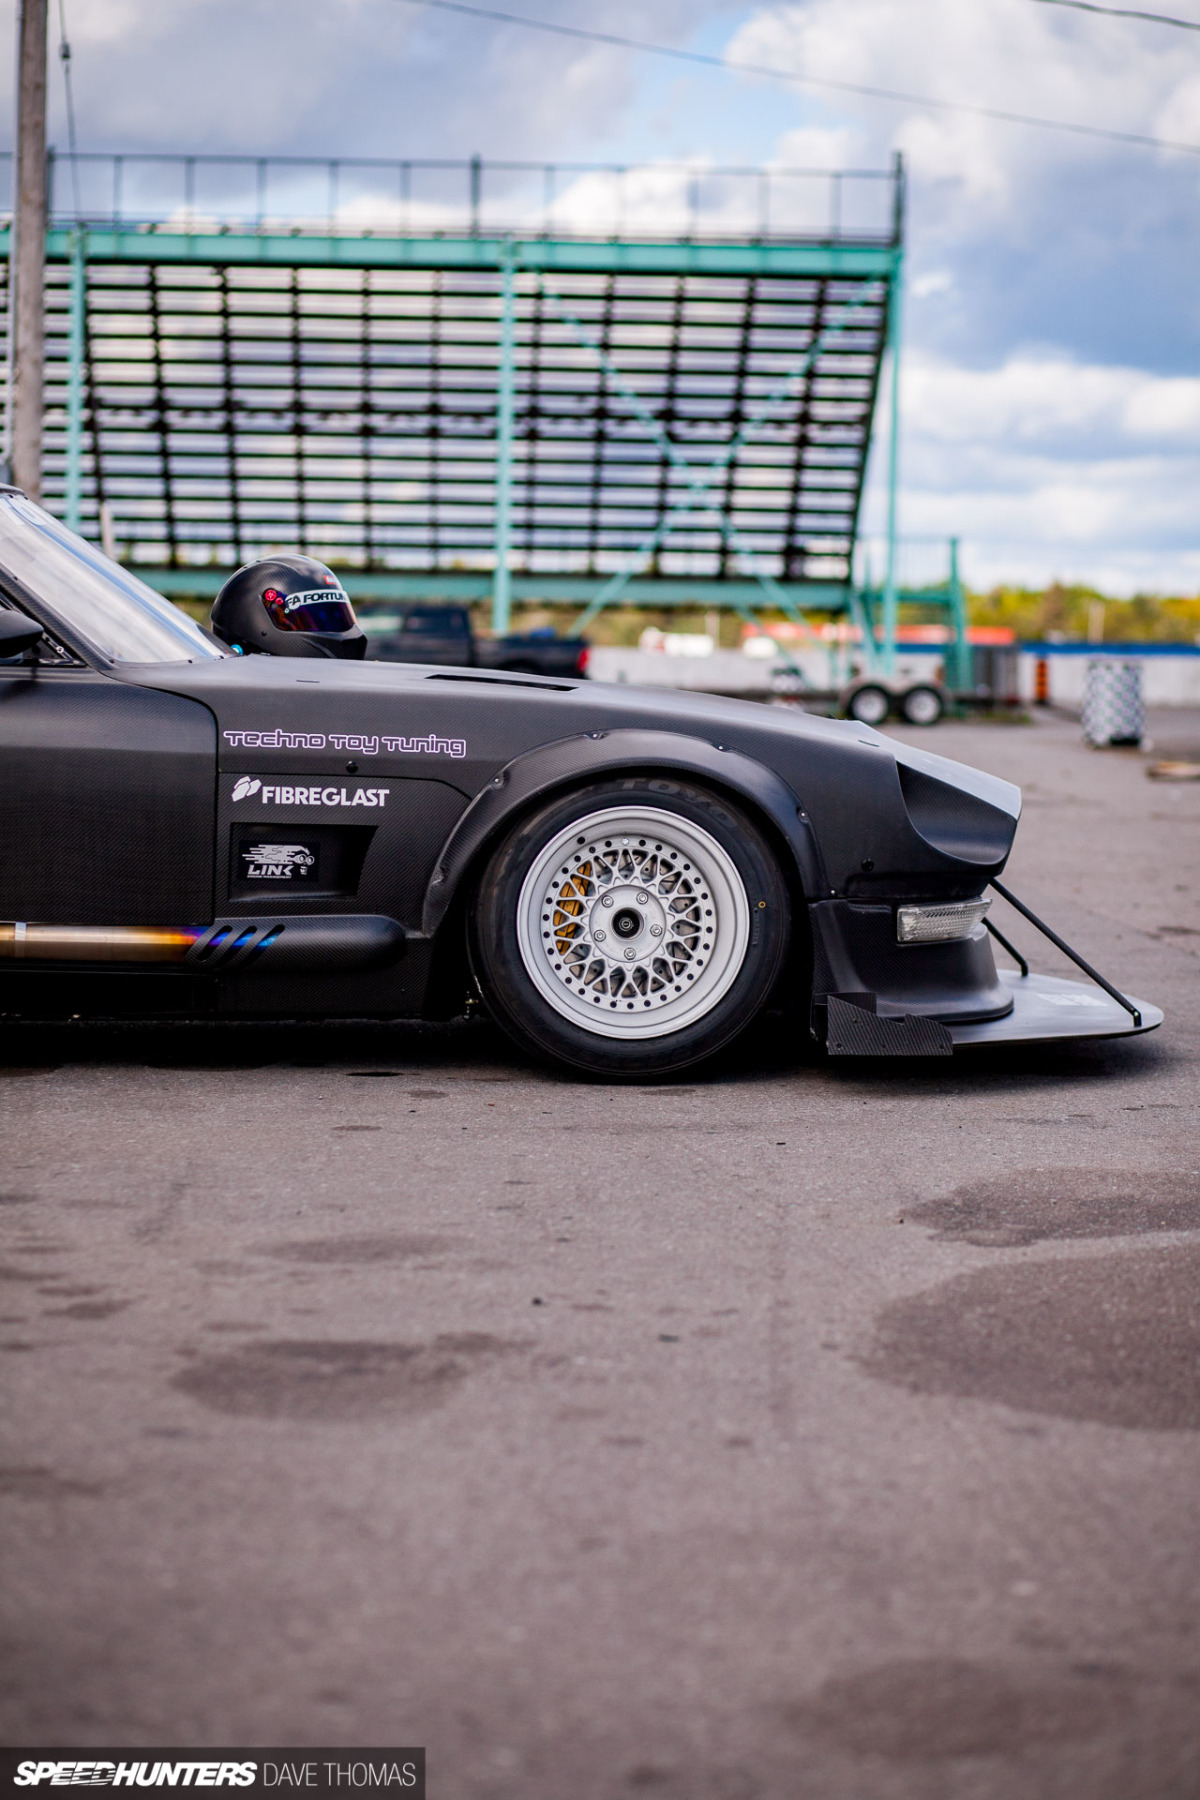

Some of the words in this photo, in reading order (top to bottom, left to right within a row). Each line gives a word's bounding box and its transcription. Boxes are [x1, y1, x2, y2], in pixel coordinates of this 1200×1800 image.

[261, 786, 390, 807] FIBREGLAST
[615, 777, 738, 828] TOYO
[247, 864, 295, 876] LINK
